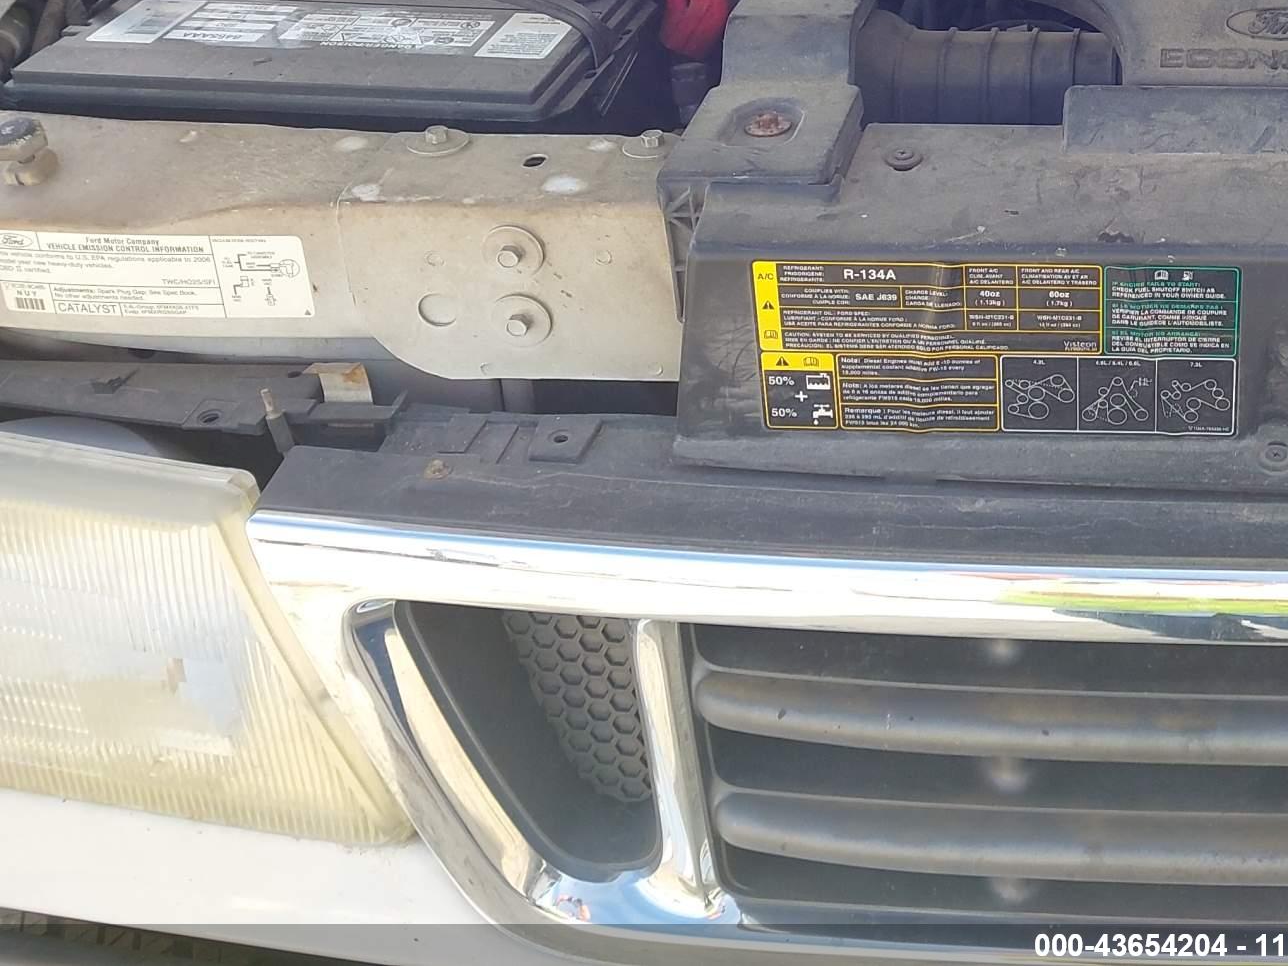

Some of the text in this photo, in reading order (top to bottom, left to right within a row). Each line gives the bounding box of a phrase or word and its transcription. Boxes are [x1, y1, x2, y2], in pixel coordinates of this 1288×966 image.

[46, 242, 76, 250] VEHICLE
[758, 272, 774, 280] A/C
[843, 268, 896, 280] R-134A
[855, 293, 875, 301] SAE
[1048, 290, 1070, 298] 60oz
[58, 302, 117, 314] CATALYST
[1063, 340, 1097, 348] Visteon
[768, 376, 795, 386] 50%
[771, 408, 798, 418] 50%
